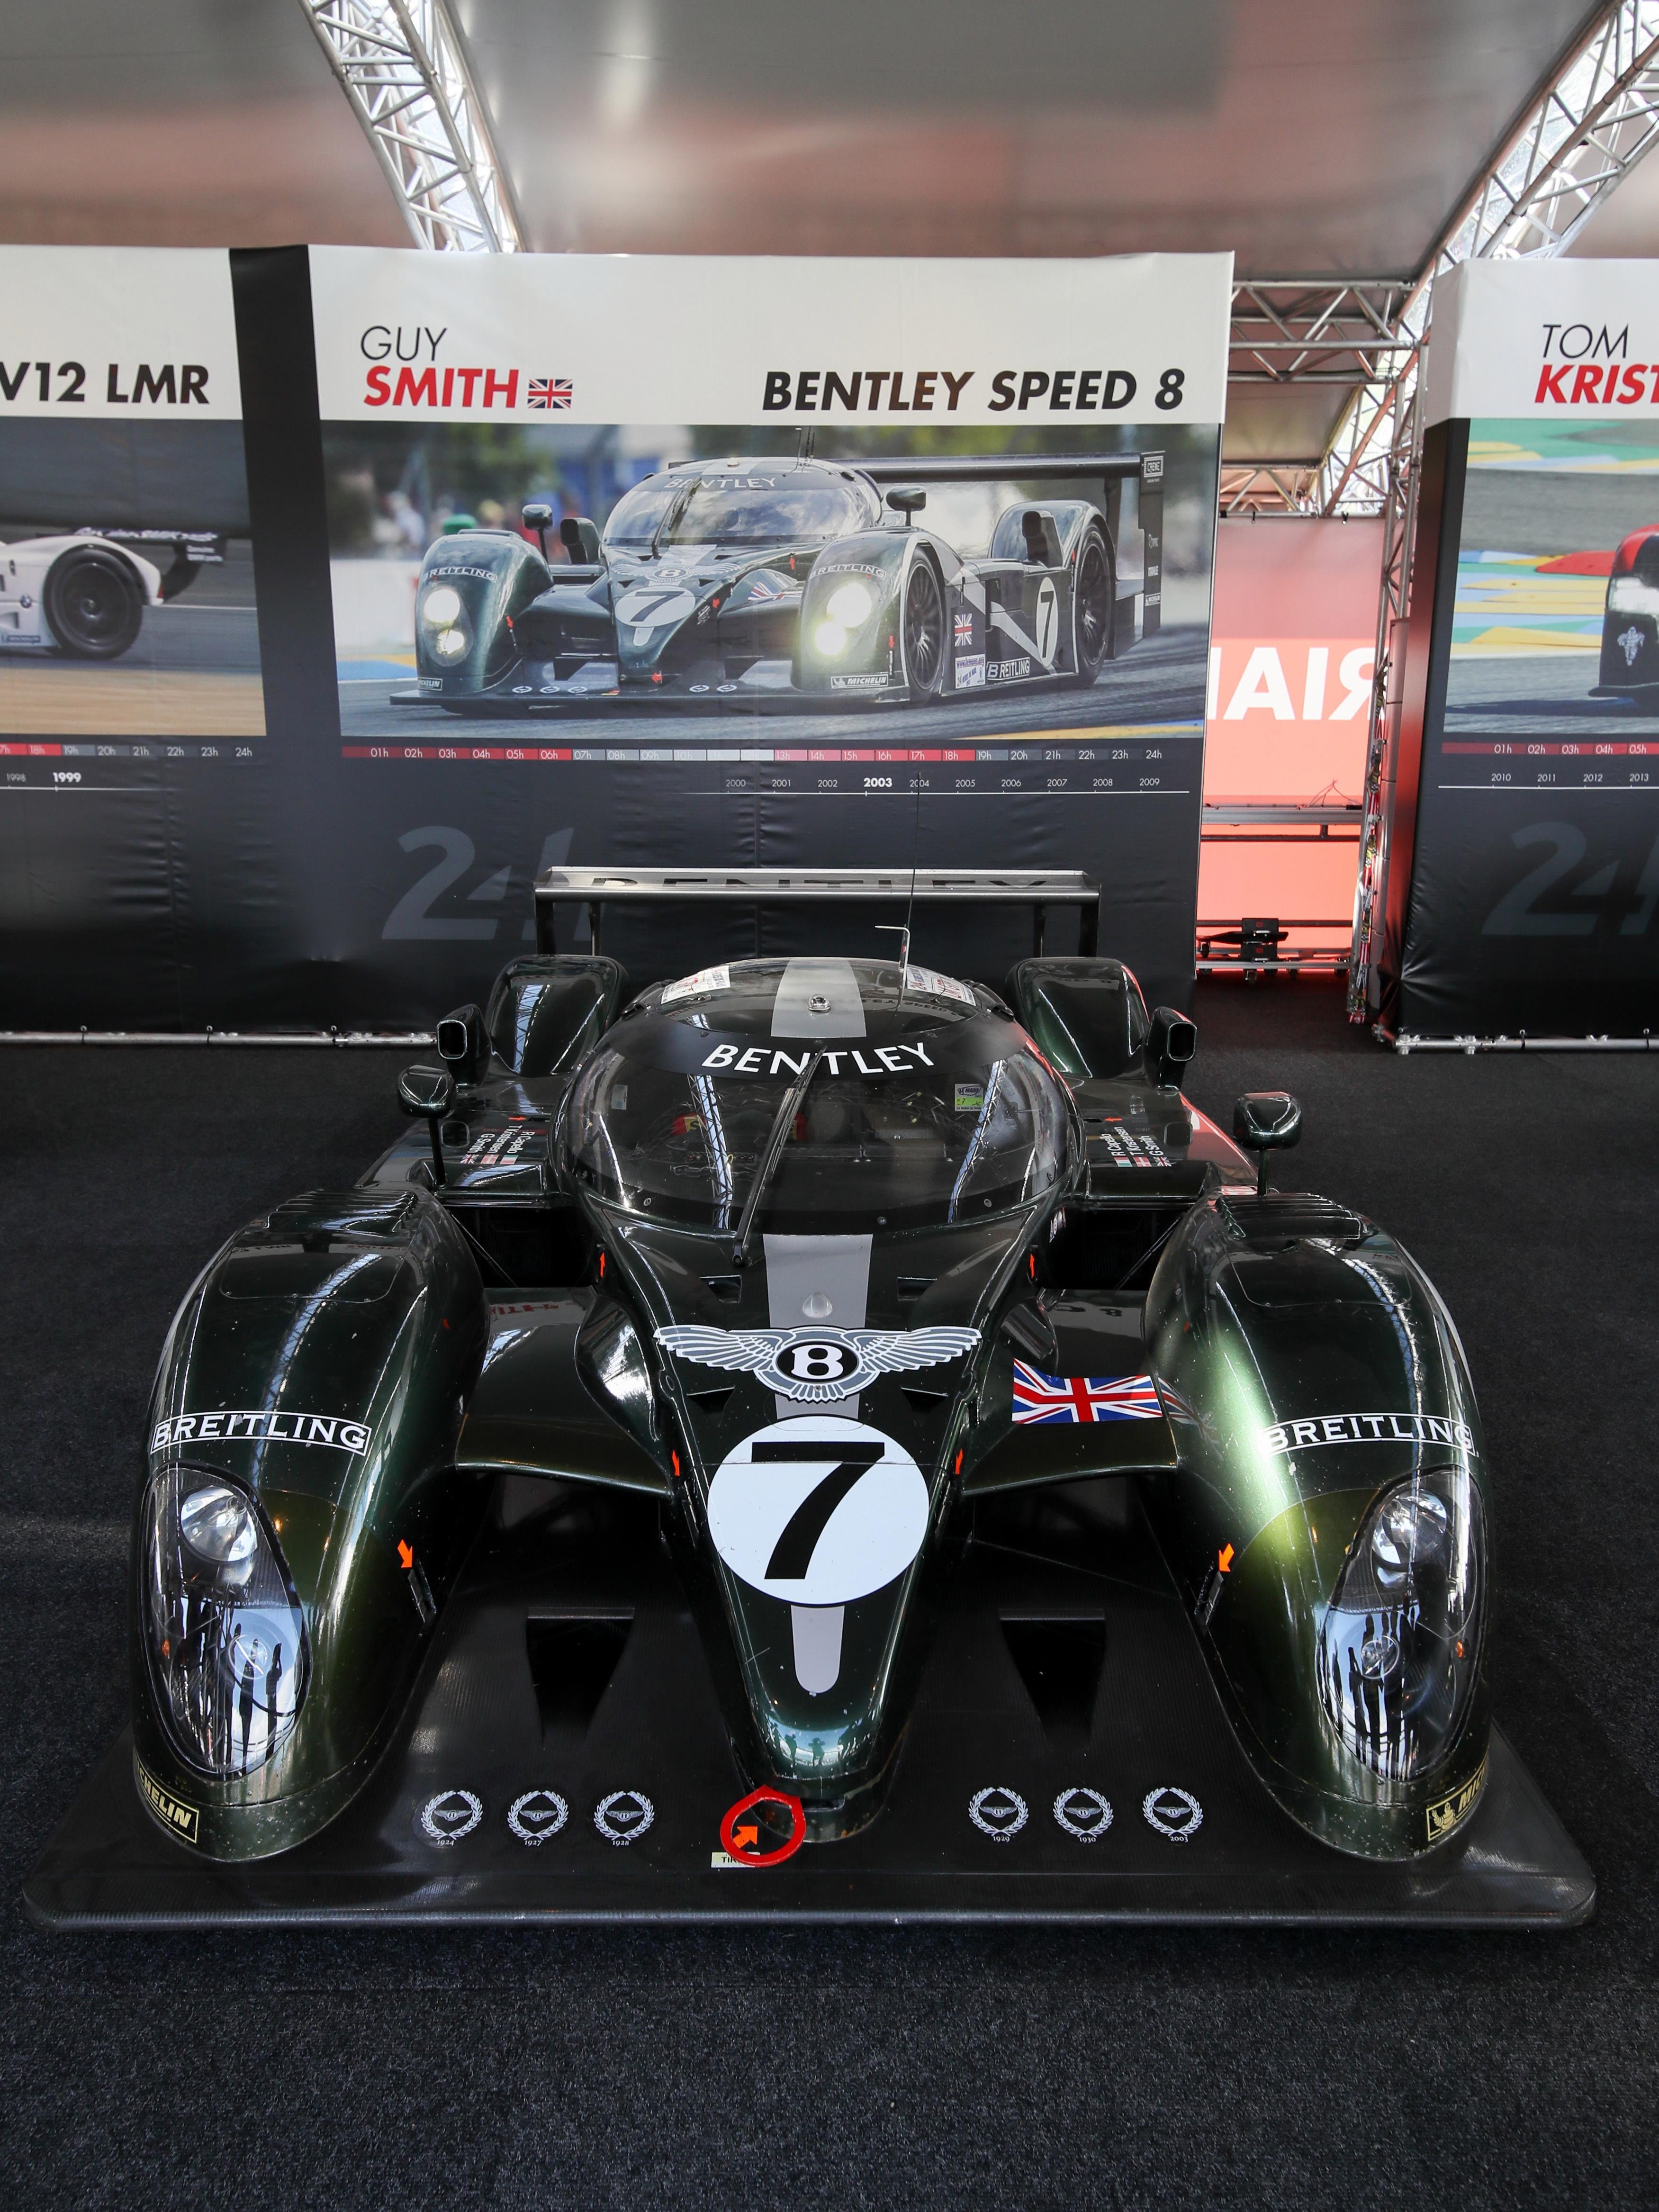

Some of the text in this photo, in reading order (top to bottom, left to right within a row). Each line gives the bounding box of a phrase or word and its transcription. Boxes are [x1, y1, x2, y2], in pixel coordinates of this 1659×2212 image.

[361, 325, 447, 361] GUY
[1542, 324, 1629, 359] TOM
[0, 361, 209, 404] V12 LMR
[364, 366, 519, 408] SMITH
[762, 369, 1185, 411] BENTLEY SPEED 8
[630, 591, 685, 623] 7
[1040, 591, 1054, 658] 7
[847, 676, 887, 685] MICHELIN
[987, 660, 1029, 678] BREITLING
[30, 745, 45, 755] 18h
[63, 745, 79, 755] 19h
[98, 745, 116, 755] 20h
[134, 745, 149, 755] 21h
[167, 747, 184, 757] 22h
[201, 747, 218, 757] 23h
[235, 747, 252, 757] 24h
[370, 748, 388, 758] 01h
[404, 749, 422, 758] 02h
[439, 749, 456, 758] 03h
[473, 749, 490, 759] 04h
[506, 749, 524, 759] 05h
[541, 750, 558, 759] 06h
[575, 750, 591, 760] 07h
[608, 750, 625, 760] 08h
[641, 751, 658, 760] 09h
[677, 751, 692, 760] 10h
[776, 750, 790, 760] 13h
[810, 750, 824, 760] 14h
[843, 750, 857, 760] 15h
[877, 750, 891, 760] 16h
[911, 750, 925, 760] 17h
[944, 750, 958, 760] 18h
[978, 750, 992, 760] 19h
[1010, 750, 1028, 760] 20h
[1046, 750, 1061, 760] 21h
[1079, 750, 1095, 759] 22h
[1112, 749, 1128, 759] 23h
[1145, 749, 1162, 759] 24h
[1494, 744, 1647, 754] 01h 02h 03h 04h 05h
[7, 772, 81, 783] 1998 1999
[818, 779, 838, 787] 2002
[864, 777, 893, 787] 2003
[910, 779, 929, 787] 2004
[956, 779, 975, 787] 2005
[1001, 778, 1021, 787] 2006
[1047, 778, 1067, 787] 2007
[1093, 778, 1113, 786] 2008
[1139, 778, 1160, 786] 2009
[1491, 773, 1649, 782] 2010 2011 2012 2013
[702, 1042, 934, 1076] BENTLEY
[791, 1345, 843, 1379] B
[154, 1414, 366, 1449] BREITLING
[1268, 1415, 1472, 1451] BREITLING
[752, 1442, 885, 1580] 7
